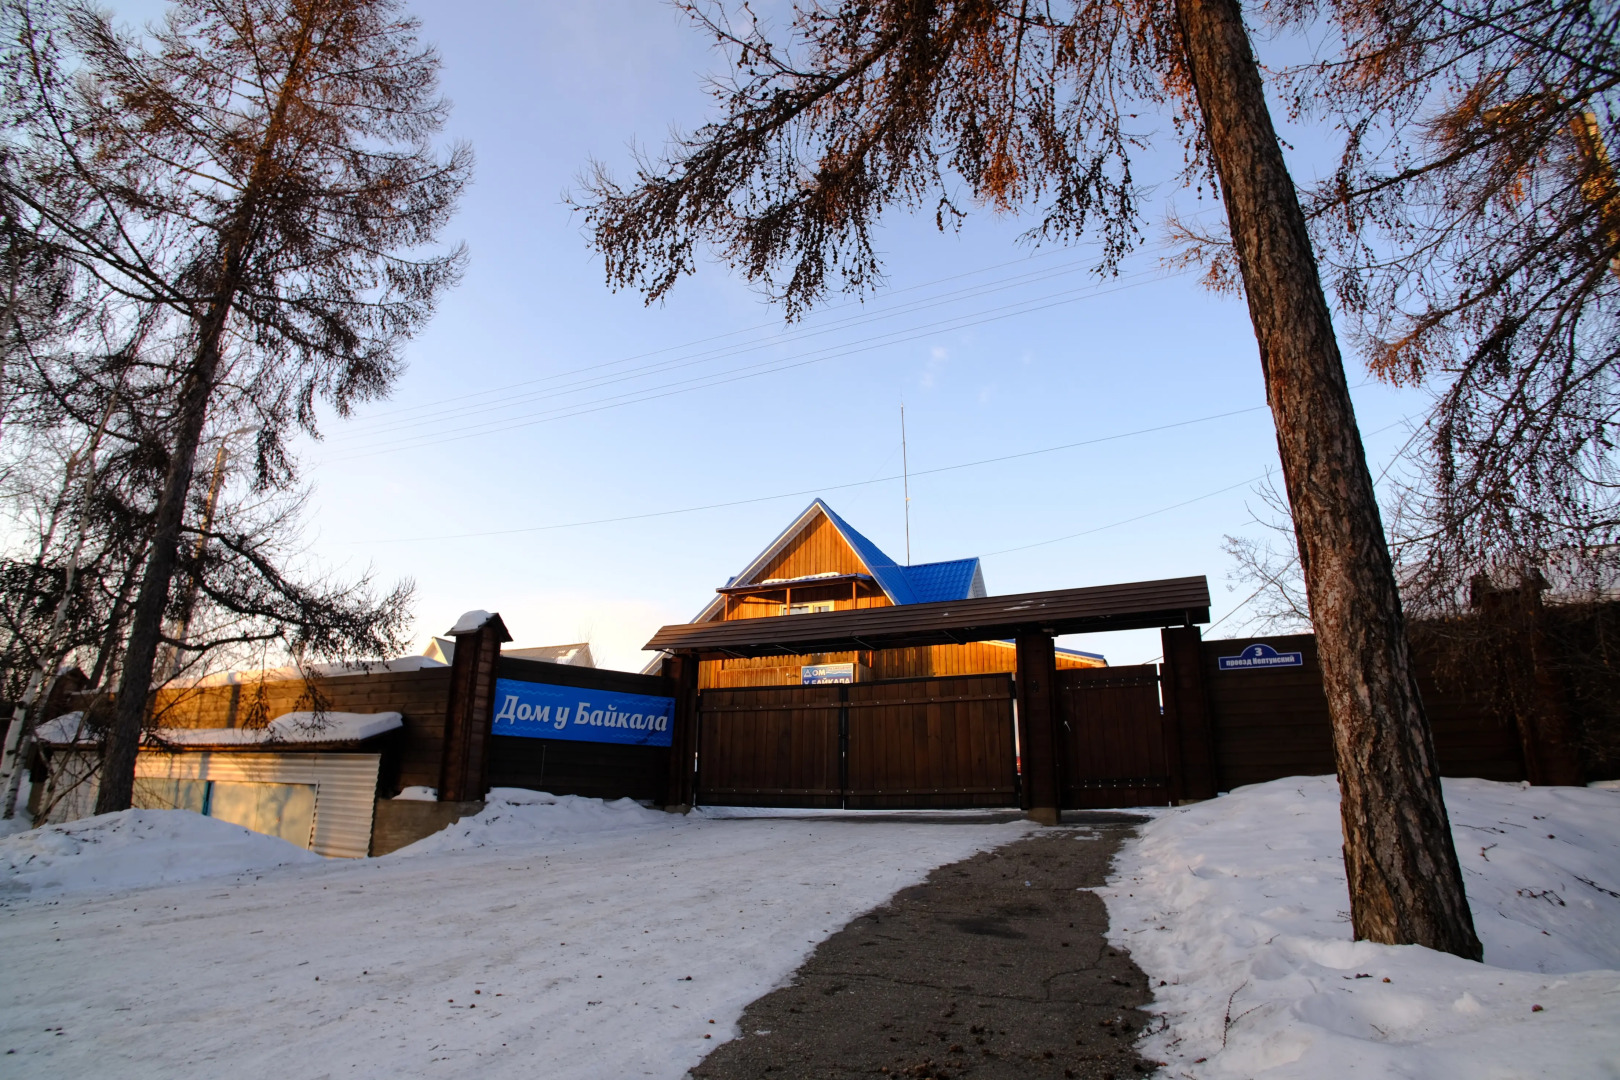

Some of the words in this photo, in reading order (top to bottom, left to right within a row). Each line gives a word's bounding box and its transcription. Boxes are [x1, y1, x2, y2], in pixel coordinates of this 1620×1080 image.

[1254, 647, 1262, 656] 3
[1252, 655, 1295, 664] Нептунский
[804, 669, 826, 677] ДОМ
[494, 694, 550, 725] Дом
[553, 706, 570, 730] у
[573, 701, 668, 732] Байкала
